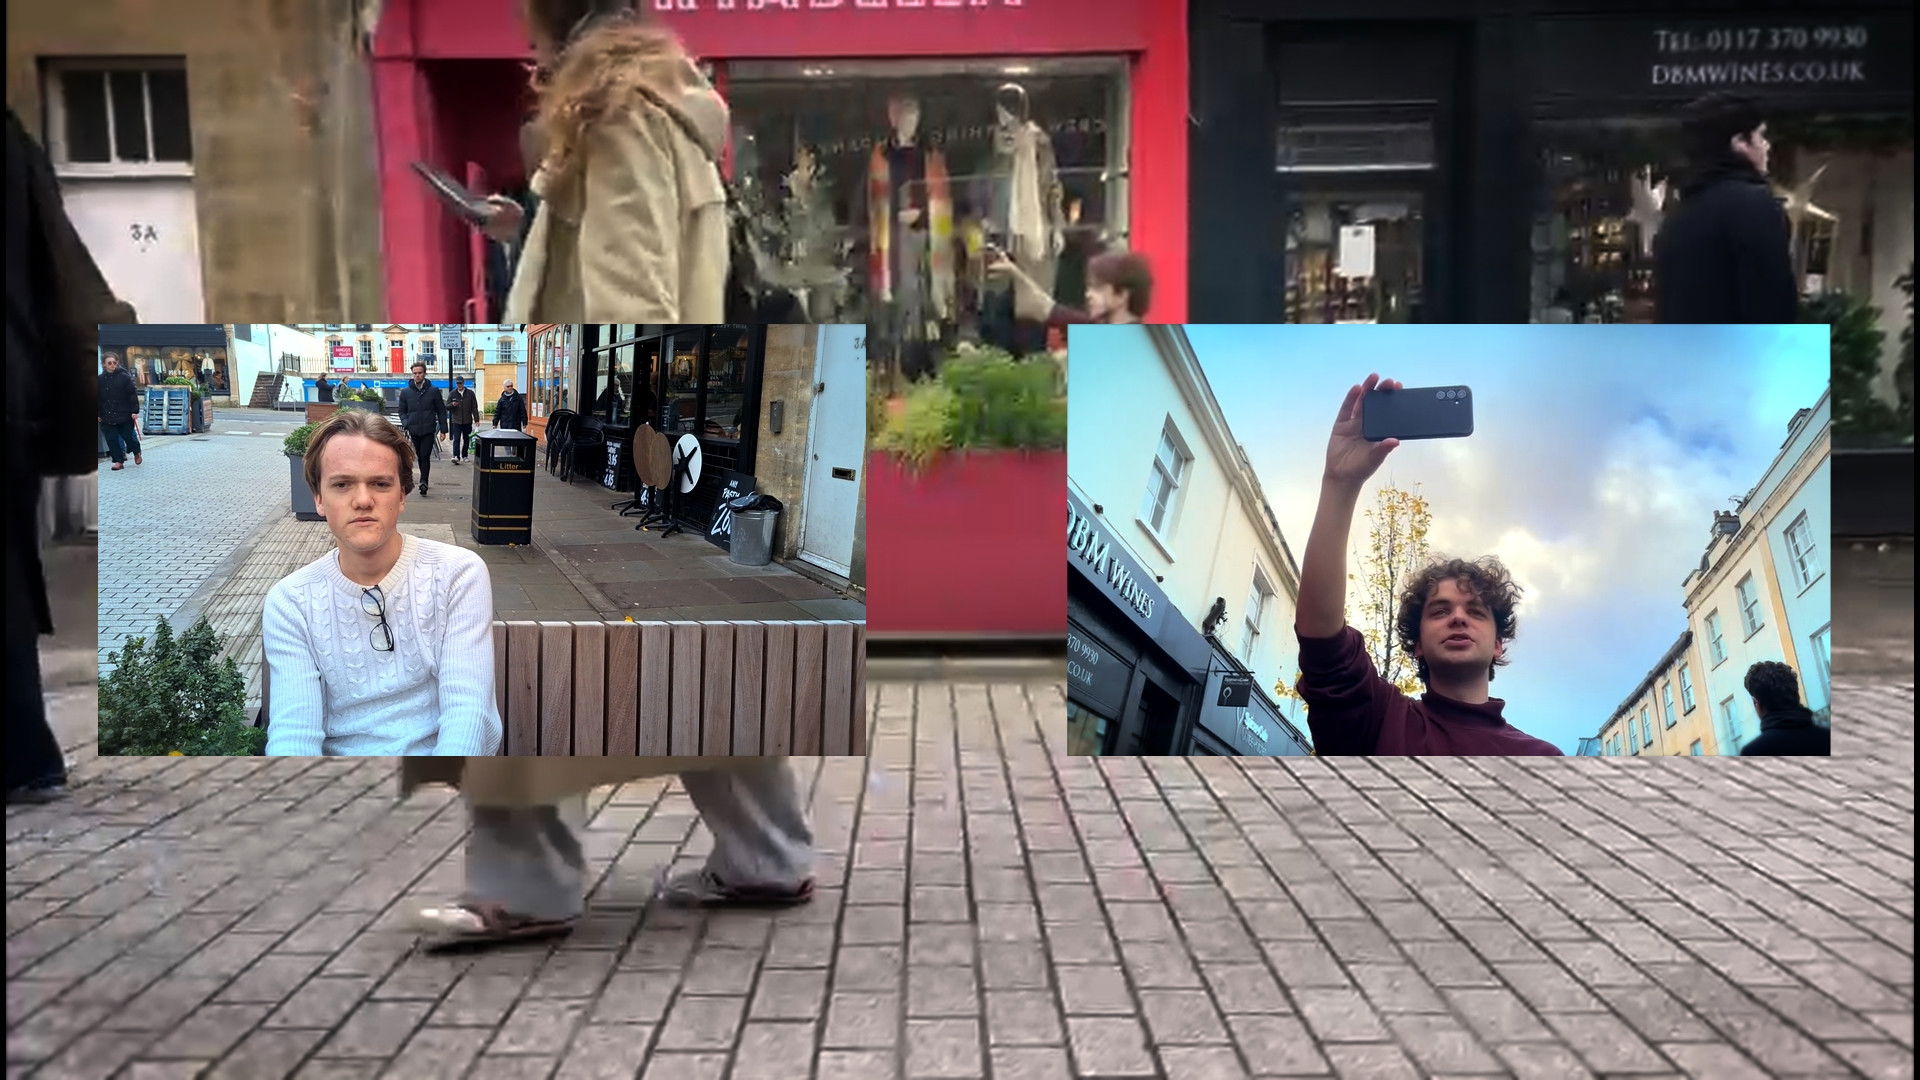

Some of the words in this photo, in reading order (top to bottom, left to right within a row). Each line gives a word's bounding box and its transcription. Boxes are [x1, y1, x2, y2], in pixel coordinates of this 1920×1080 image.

[1706, 29, 1760, 50] 0117
[1768, 27, 1808, 49] 370
[1813, 26, 1868, 48] 9930
[1652, 62, 1864, 84] DBMWINES.CO.UK
[130, 224, 158, 241] 3A
[1111, 557, 1155, 619] WINES
[1081, 643, 1099, 665] 9930
